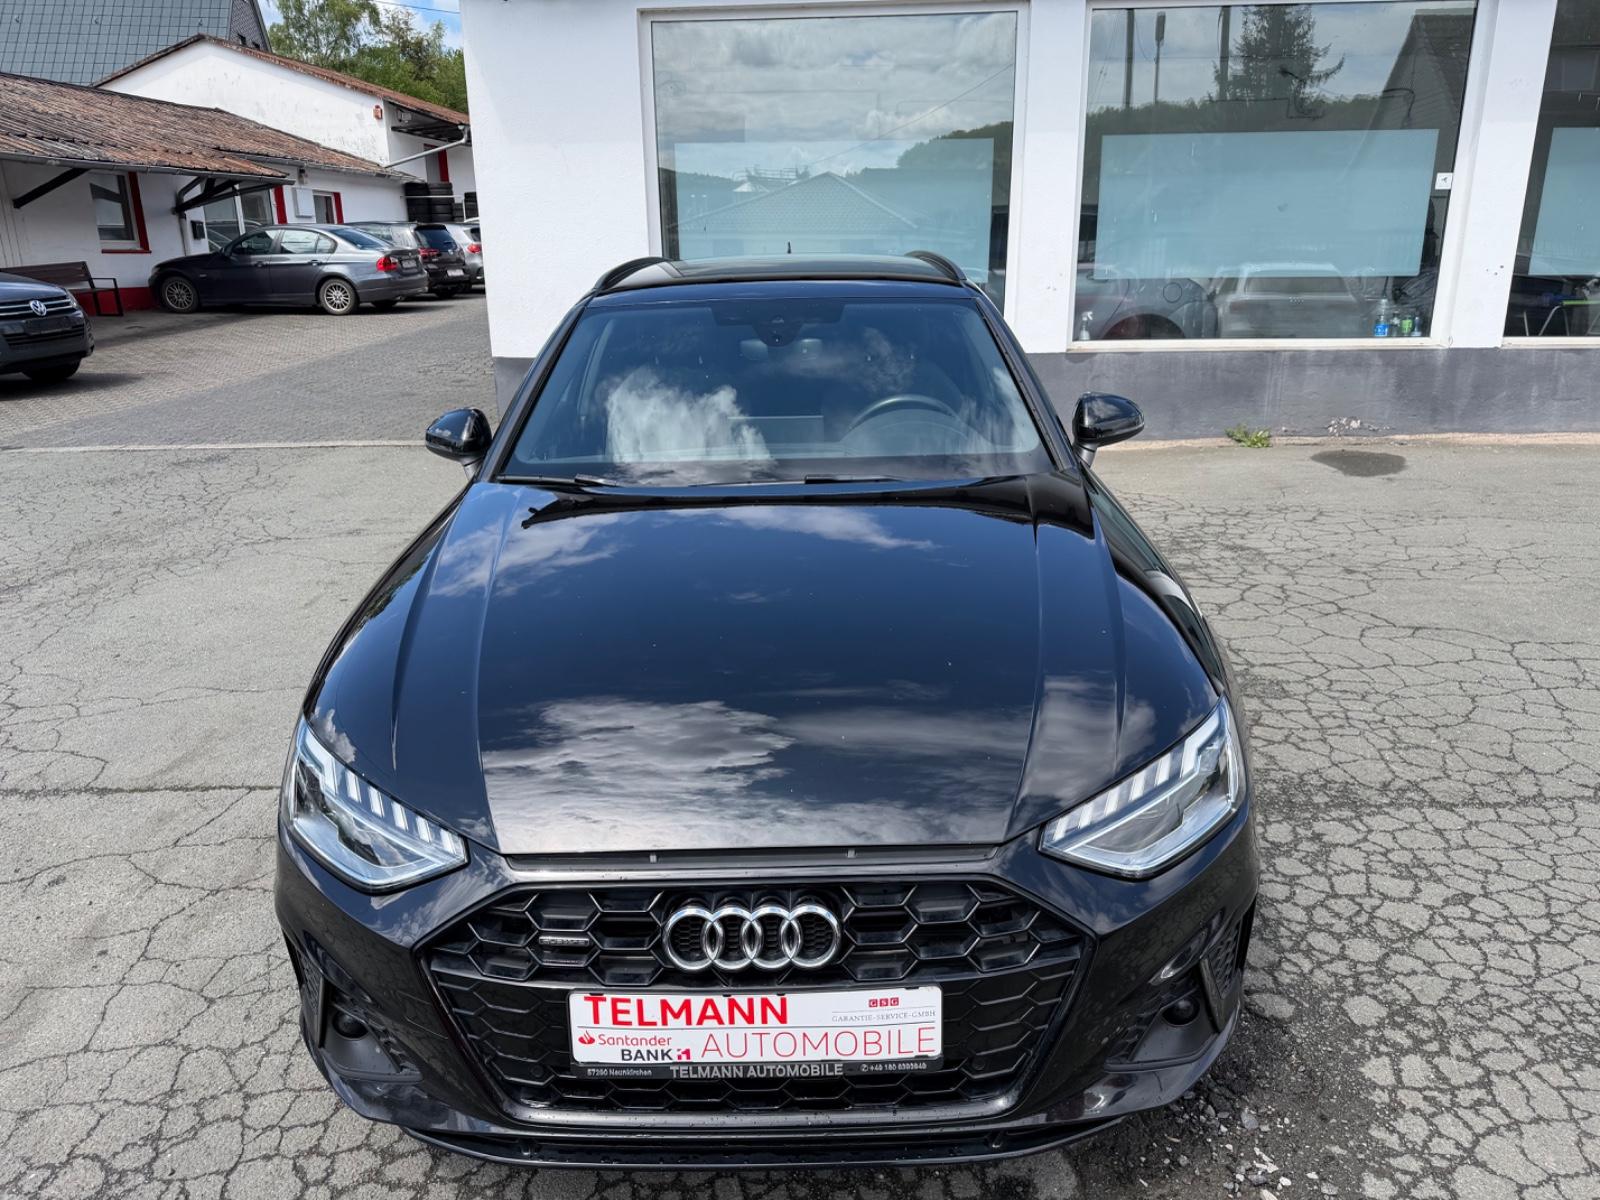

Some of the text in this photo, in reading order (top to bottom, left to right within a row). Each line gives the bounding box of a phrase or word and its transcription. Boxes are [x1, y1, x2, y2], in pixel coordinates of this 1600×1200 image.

[584, 995, 788, 1026] TELMANN
[598, 1033, 672, 1046] Santander
[701, 1026, 936, 1058] AUTOMOBILE
[670, 1063, 844, 1079] TELMANN AUTOMOBILE
